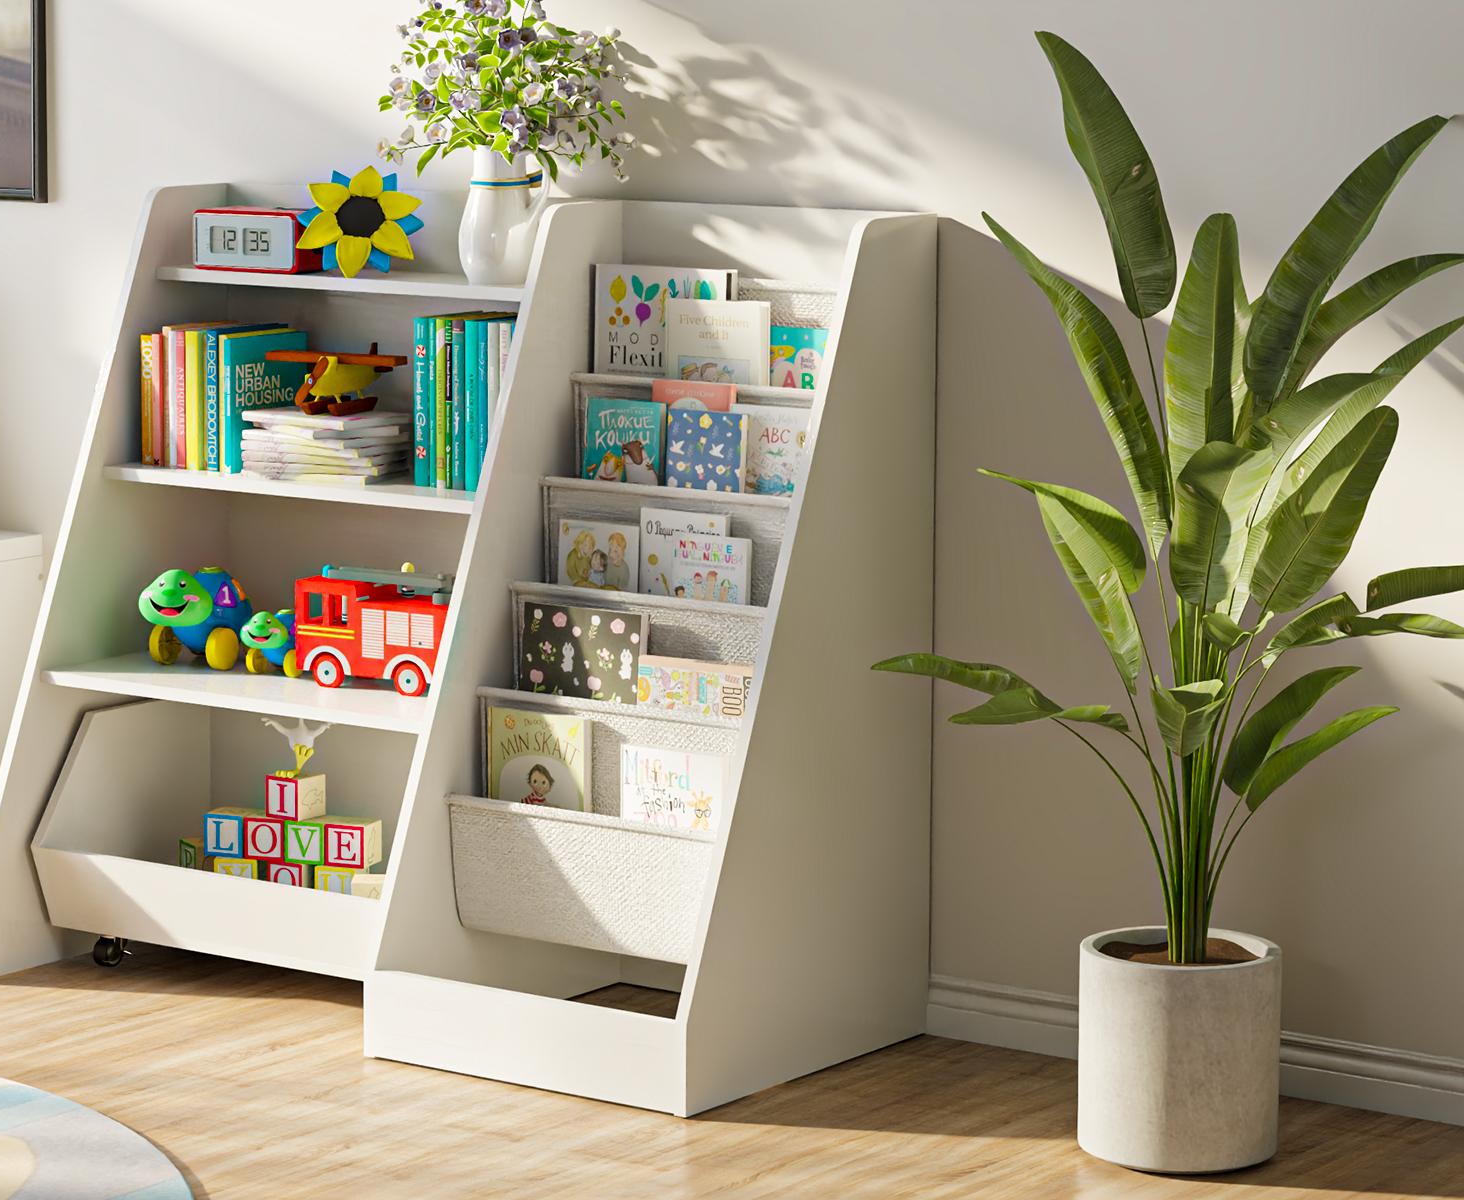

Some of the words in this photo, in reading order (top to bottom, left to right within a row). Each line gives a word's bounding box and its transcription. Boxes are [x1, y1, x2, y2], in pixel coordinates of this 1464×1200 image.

[223, 229, 236, 251] 12
[249, 230, 269, 252] 35
[679, 314, 702, 325] Five
[703, 314, 750, 328] Children
[698, 329, 719, 340] and
[141, 339, 153, 380] 1000
[207, 333, 217, 383] ALEXEY
[235, 362, 265, 379] NEW
[235, 375, 281, 393] URBAN
[235, 387, 294, 408] HOUSING
[759, 427, 791, 444] ABC
[222, 585, 232, 604] 1
[500, 732, 530, 760] MIN
[533, 731, 581, 765] SKATT
[624, 749, 691, 791] Mitford
[276, 783, 288, 814] I
[212, 820, 357, 862] LOVE
